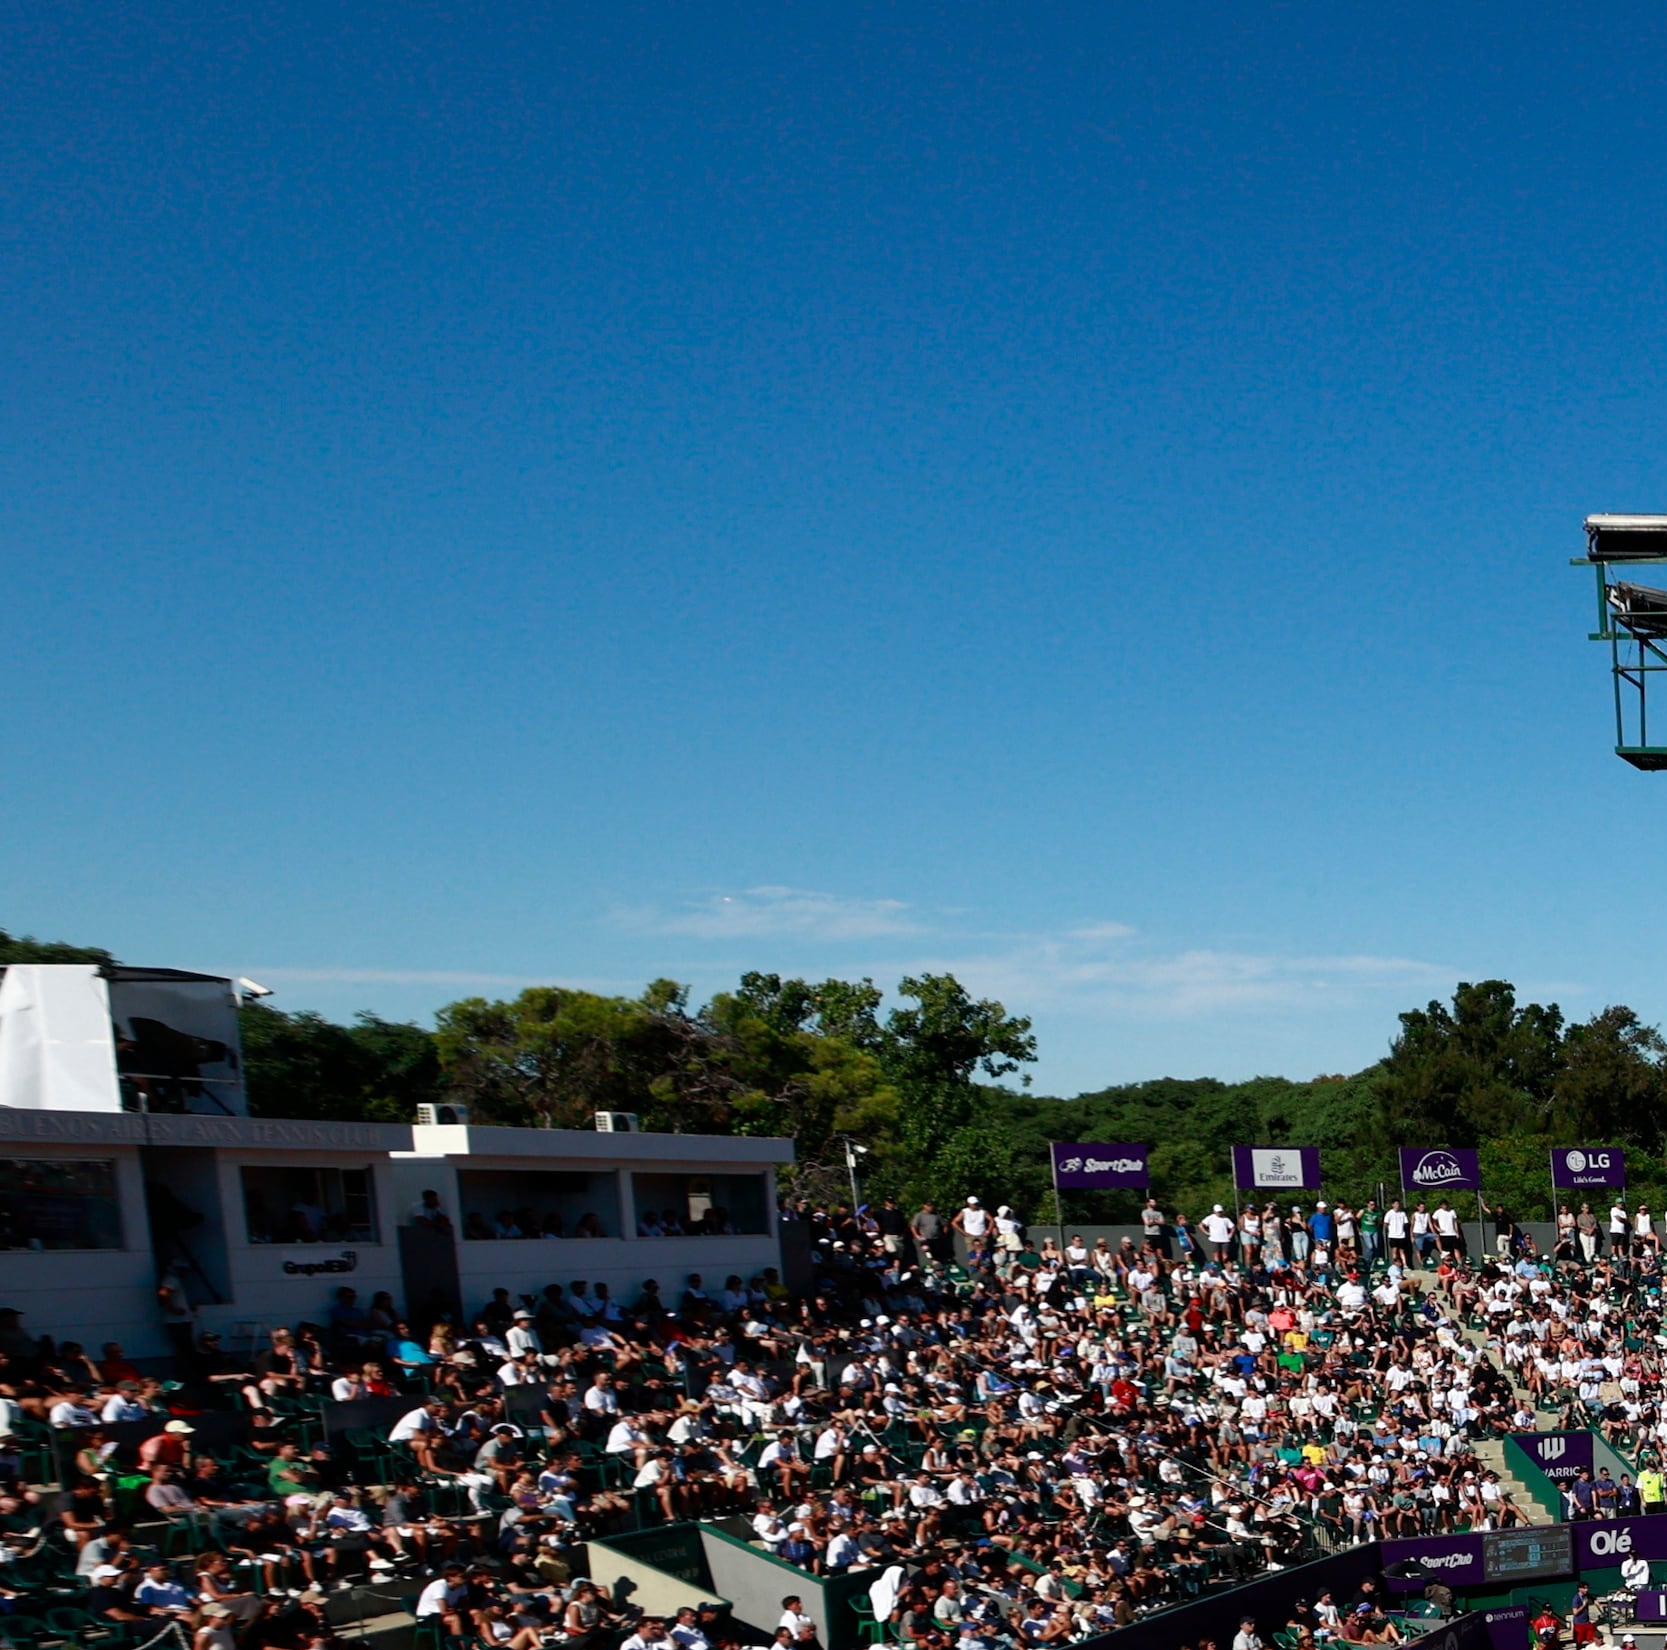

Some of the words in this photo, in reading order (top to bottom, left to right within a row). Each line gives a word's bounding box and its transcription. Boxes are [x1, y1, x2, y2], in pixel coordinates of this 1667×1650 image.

[1083, 1158, 1144, 1173] SportClub
[1588, 1153, 1610, 1168] LG
[1259, 1172, 1299, 1182] Emirates
[1422, 1164, 1461, 1180] McCain
[1590, 1527, 1632, 1556] Olé
